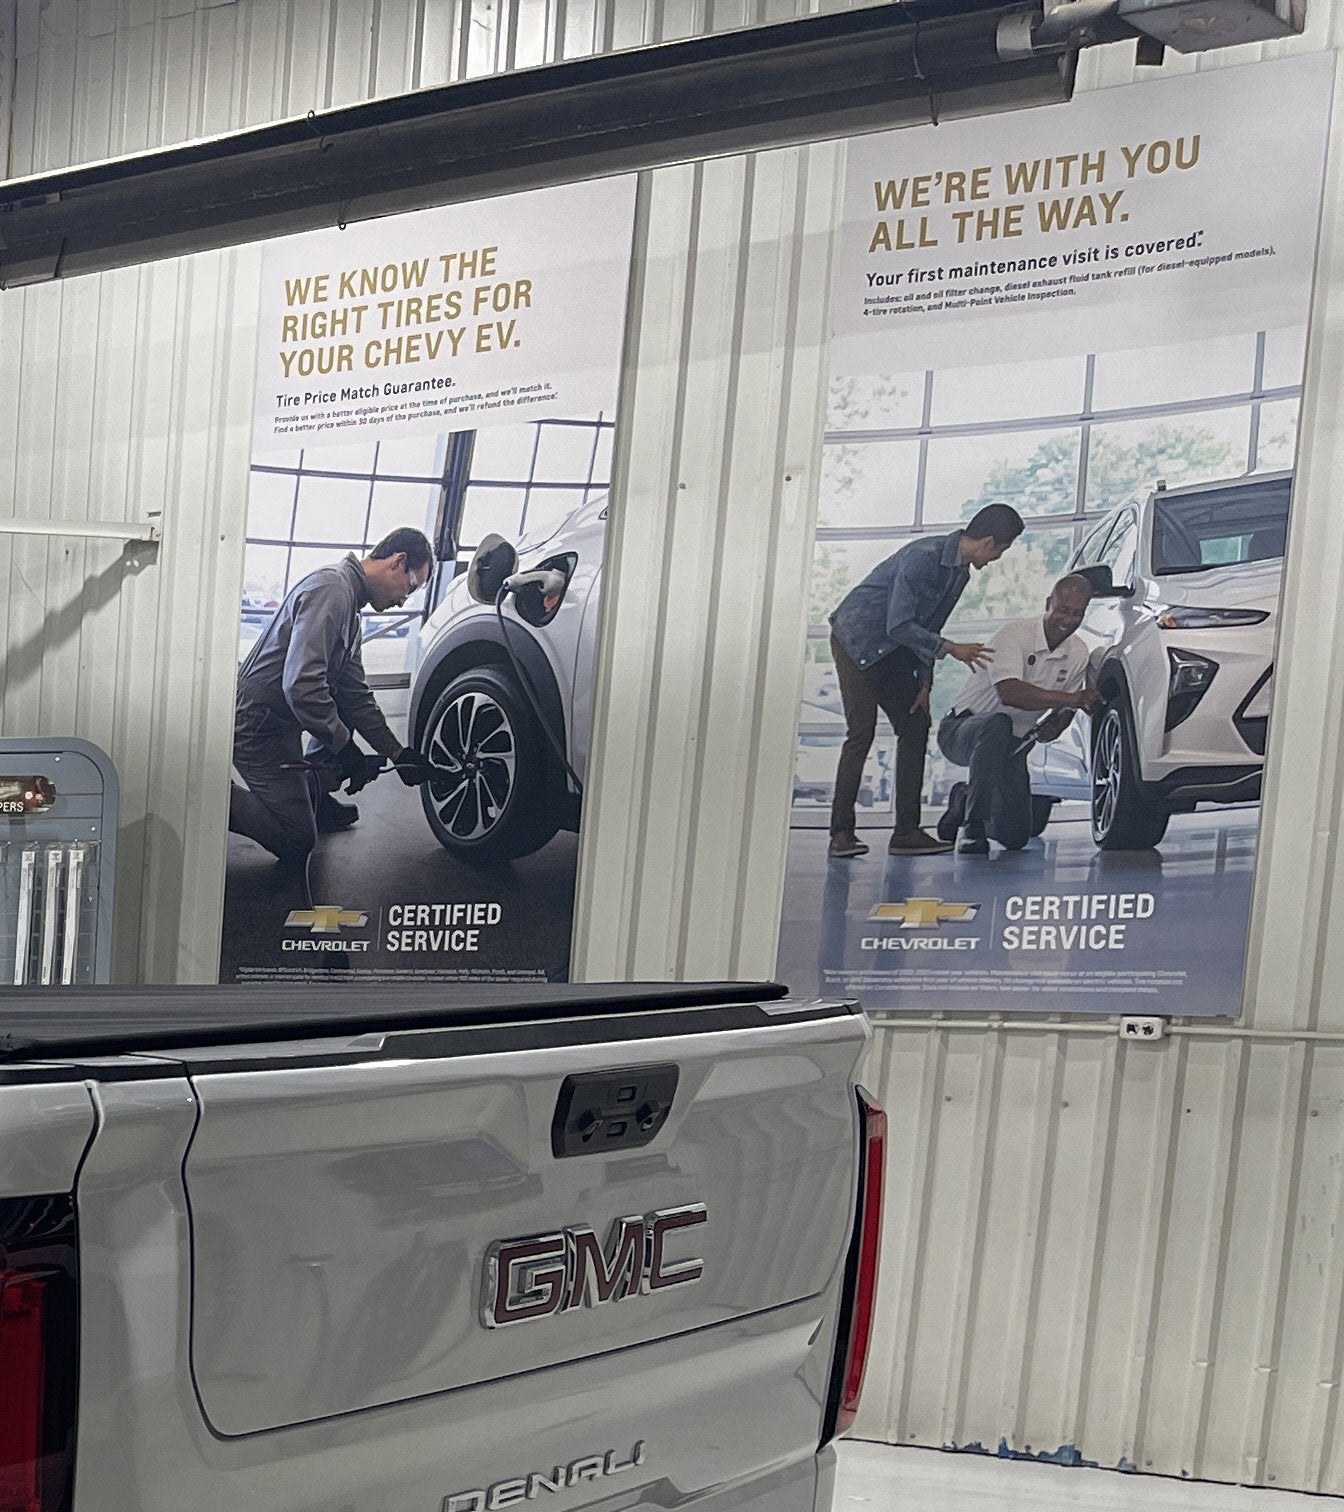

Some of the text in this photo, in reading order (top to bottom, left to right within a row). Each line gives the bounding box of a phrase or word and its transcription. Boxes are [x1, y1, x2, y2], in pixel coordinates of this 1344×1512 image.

[1004, 149, 1106, 194] WITH
[1119, 134, 1201, 178] YOU
[869, 190, 1130, 253] ALL THE WAY.
[285, 246, 498, 306] WE KNOW THE
[866, 272, 904, 288] Your
[907, 267, 944, 284] first
[948, 255, 1058, 280] maintenance
[1062, 247, 1100, 266] visit
[1104, 244, 1119, 260] is
[904, 294, 914, 302] oil
[916, 291, 932, 301] and
[933, 289, 944, 299] oil
[945, 288, 967, 298] filter
[969, 285, 1002, 296] change,
[1004, 281, 1030, 292] diesel
[1032, 276, 1067, 288] exhaust
[1069, 274, 1090, 284] fluid
[1091, 270, 1112, 281] tank
[1114, 266, 1136, 278] refill
[1138, 264, 1155, 276] (for
[1157, 252, 1233, 272] diesel-equipped
[282, 279, 532, 342] RIGHT TIRES FOR
[889, 304, 926, 315] rotation,
[927, 302, 943, 311] and
[944, 297, 992, 309] Multi-Point
[994, 293, 1026, 304] Vehicle
[1027, 287, 1076, 300] Inspection.
[279, 319, 521, 378] YOUR CHEVY EV.
[276, 377, 456, 408] Tire Price Match Guarantee.
[310, 412, 326, 420] with
[332, 409, 353, 418] better
[381, 404, 398, 414] price
[440, 397, 448, 405] of
[486, 390, 499, 398] and
[519, 384, 542, 394] match
[274, 426, 288, 434] Find
[295, 424, 316, 432] better
[317, 422, 334, 431] price
[336, 418, 357, 428] within
[368, 416, 385, 426] days
[386, 414, 394, 422] of
[395, 412, 407, 421] the
[444, 406, 458, 414] and
[477, 401, 501, 410] refund
[388, 902, 502, 926] CERTIFIED
[1005, 892, 1155, 921] CERTIFIED
[282, 939, 370, 952] CHEVROLET
[386, 929, 480, 952] SERVICE
[860, 936, 981, 950] CHEVROLET
[1002, 924, 1126, 950] SERVICE
[481, 1201, 708, 1329] GMC
